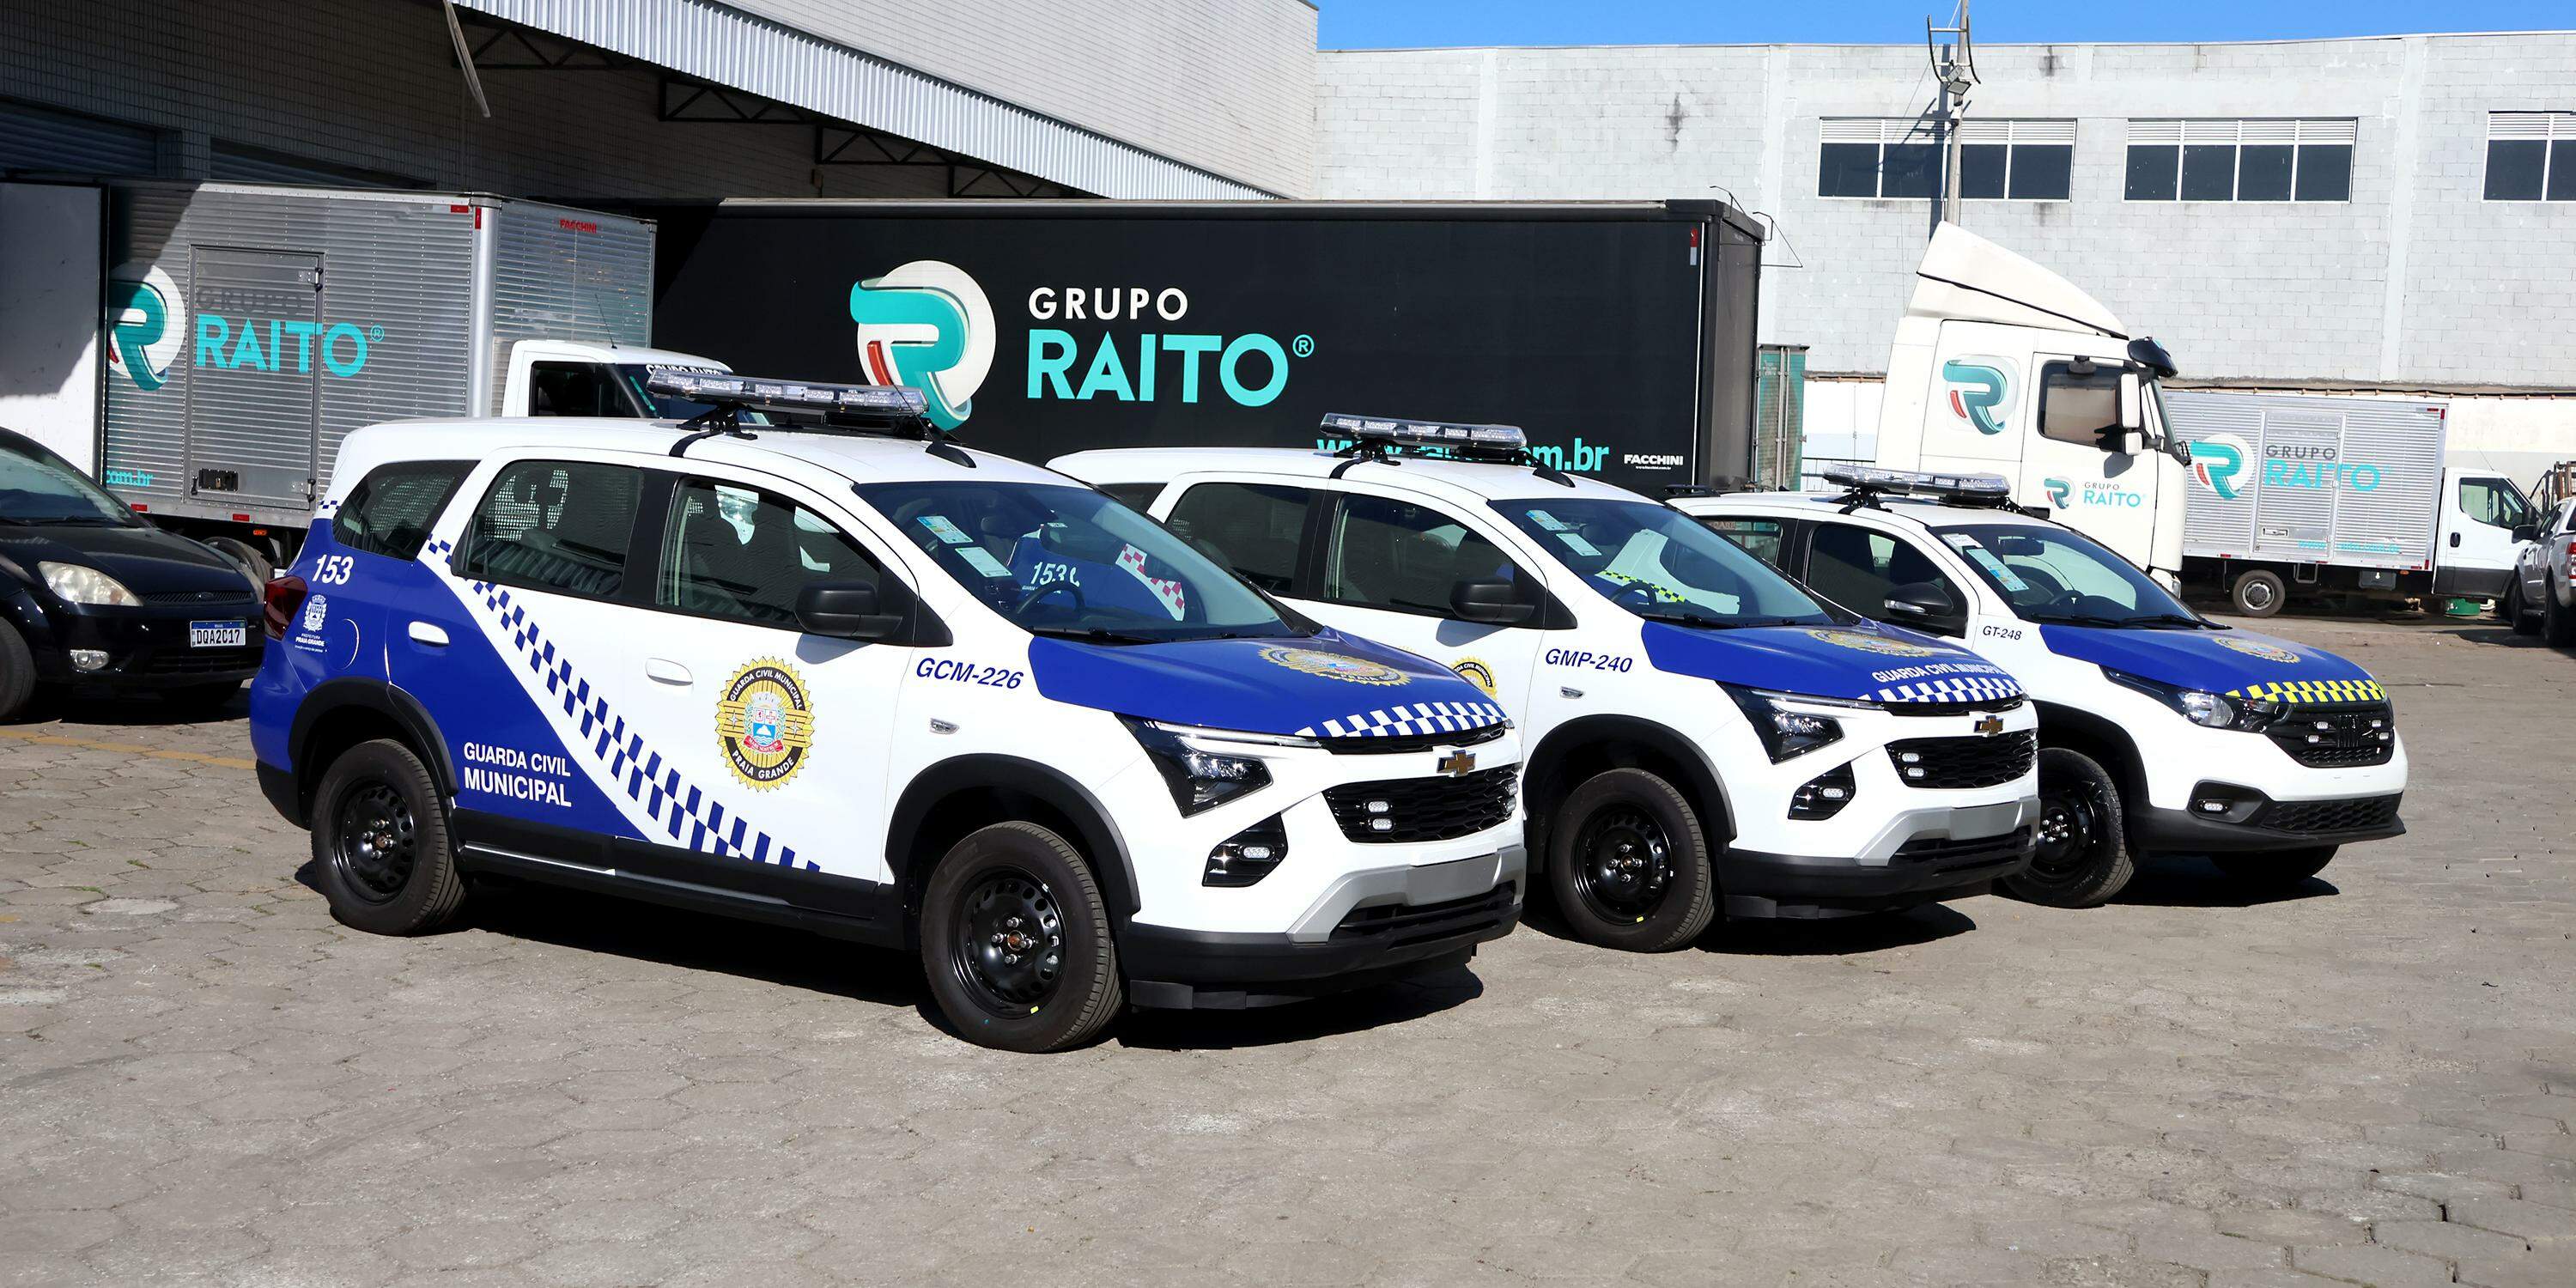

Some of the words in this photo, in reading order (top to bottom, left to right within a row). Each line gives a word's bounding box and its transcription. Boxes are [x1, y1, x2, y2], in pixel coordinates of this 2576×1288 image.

[1029, 287, 1188, 321] GRUPO
[1624, 454, 1684, 465] FACCHINI
[2266, 445, 2336, 460] GRUPO
[2084, 482, 2120, 490] GRUPO
[312, 554, 354, 585] 153
[196, 629, 240, 645] DQA2C17
[1983, 625, 2022, 641] GT-248
[916, 658, 1024, 690] GCM-226
[1546, 648, 1633, 673] GMP-240
[1872, 667, 1929, 683] GUARDA
[1925, 663, 1959, 674] CIVIL
[730, 674, 754, 702] GUARDA
[756, 670, 773, 679] CIVIL
[775, 671, 802, 709] MUNICIPAL
[464, 742, 527, 769] GUARDA
[531, 753, 571, 777] CIVIL
[732, 750, 754, 776] PRAIA
[758, 757, 794, 779] GRANDE
[464, 767, 572, 807] MUNICIPAL
